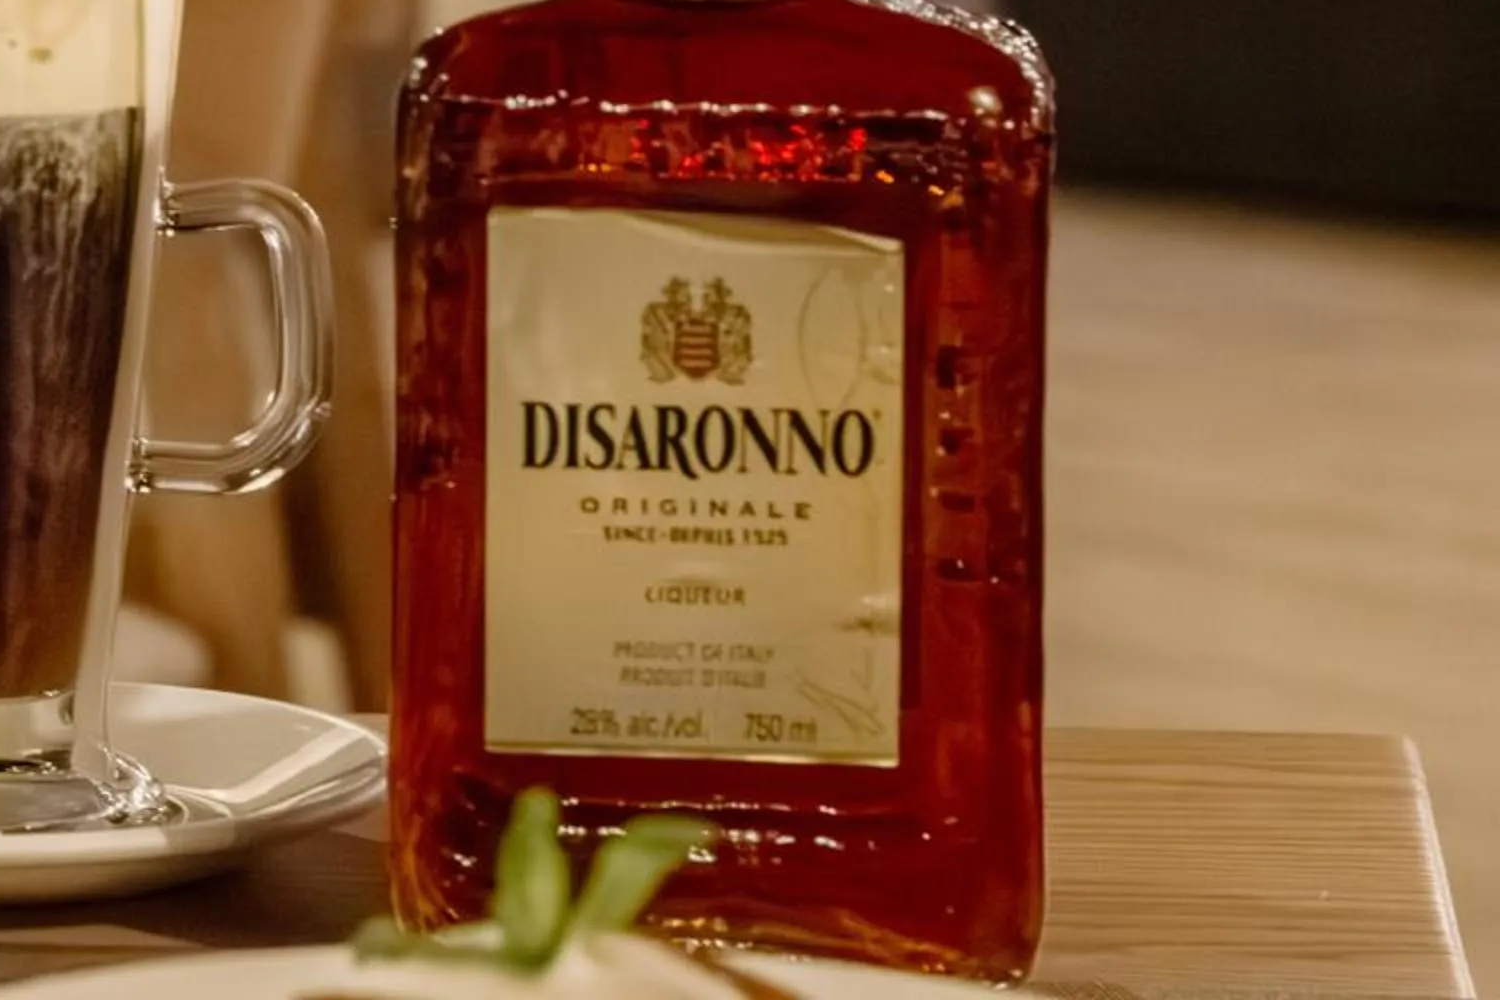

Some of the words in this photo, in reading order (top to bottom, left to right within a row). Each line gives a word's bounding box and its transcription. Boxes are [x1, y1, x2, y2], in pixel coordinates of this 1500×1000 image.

[521, 401, 875, 479] DISARONNO
[580, 497, 812, 520] ORIGINALE
[644, 586, 746, 605] LIQUEUR
[744, 712, 784, 742] 750
